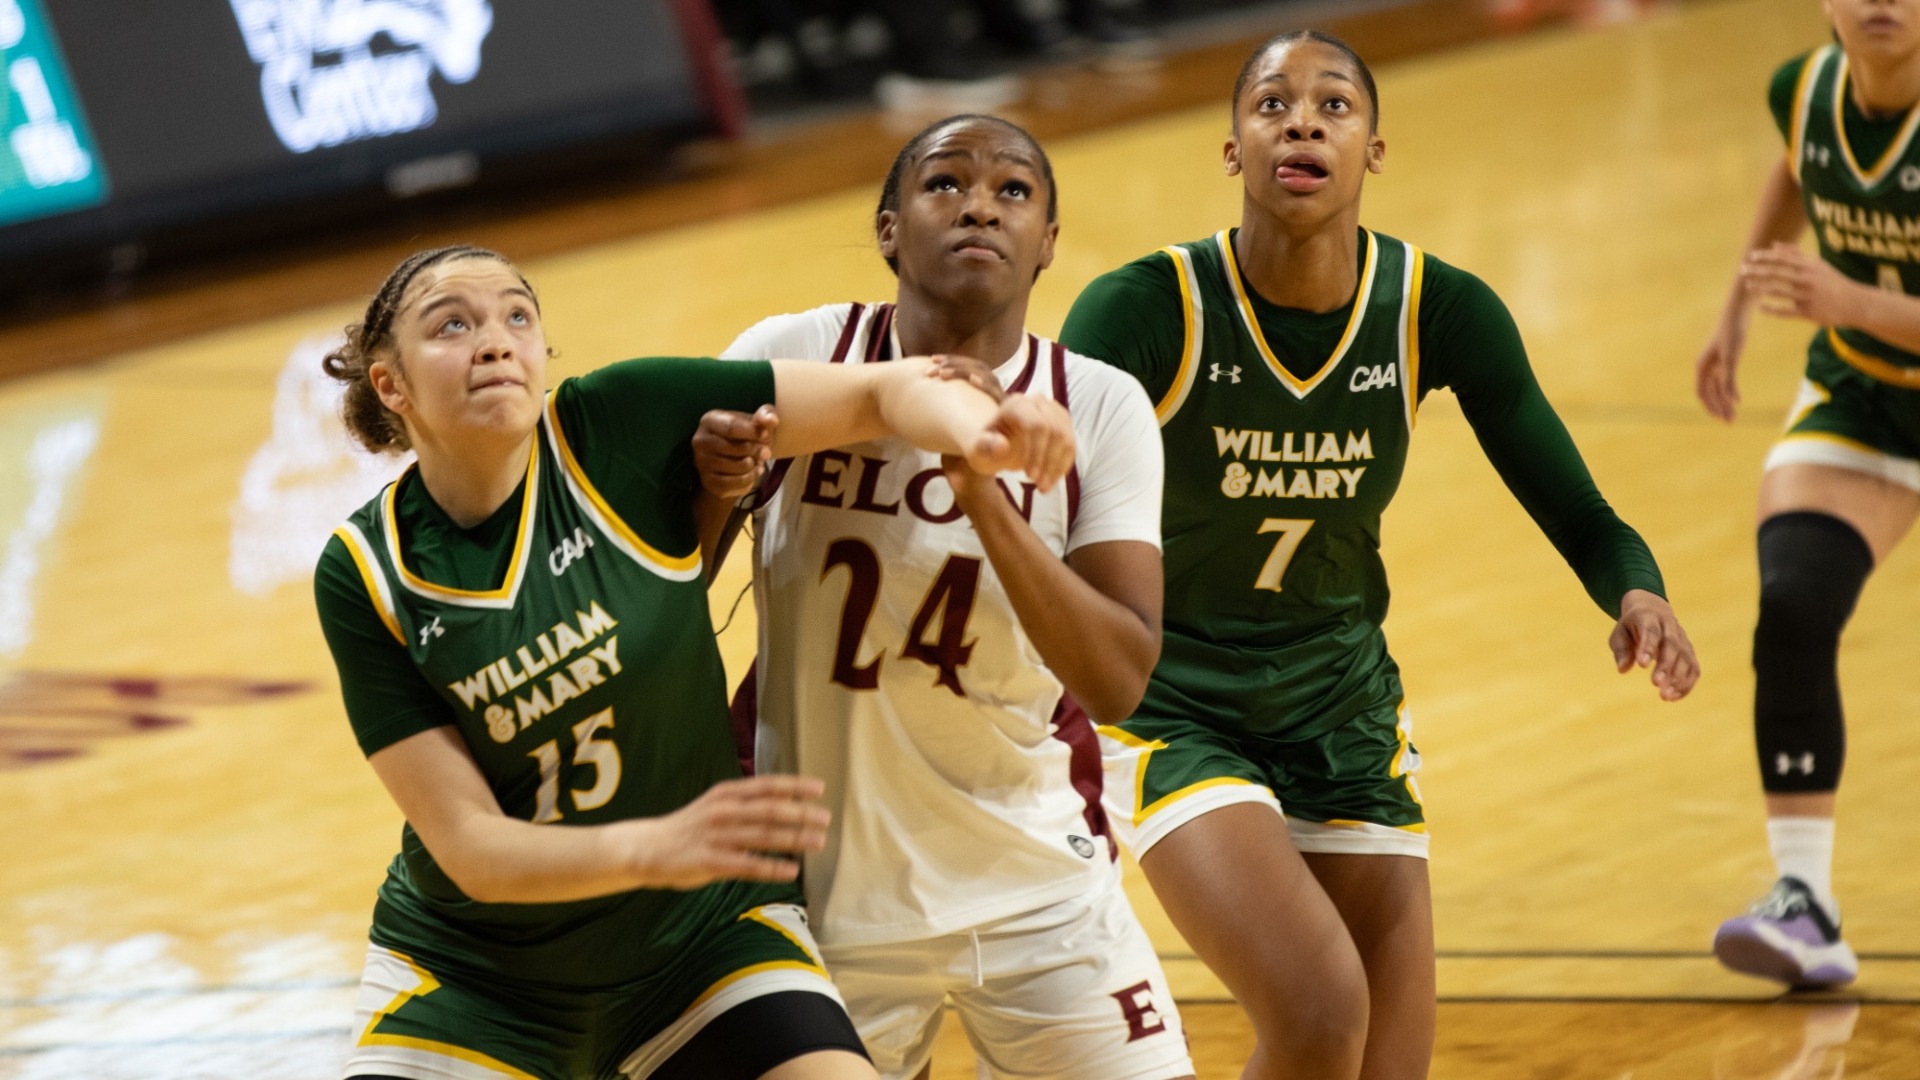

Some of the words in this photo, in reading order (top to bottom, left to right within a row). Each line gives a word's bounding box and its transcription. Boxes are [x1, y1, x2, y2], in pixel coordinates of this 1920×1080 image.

[1349, 362, 1397, 392] CAA
[1211, 425, 1375, 463] WILLIAM
[549, 526, 594, 576] CAA
[1253, 517, 1316, 593] 7
[819, 535, 983, 698] 24
[448, 600, 618, 712] WILLIAM
[527, 704, 622, 825] 15
[1109, 979, 1167, 1043] E
